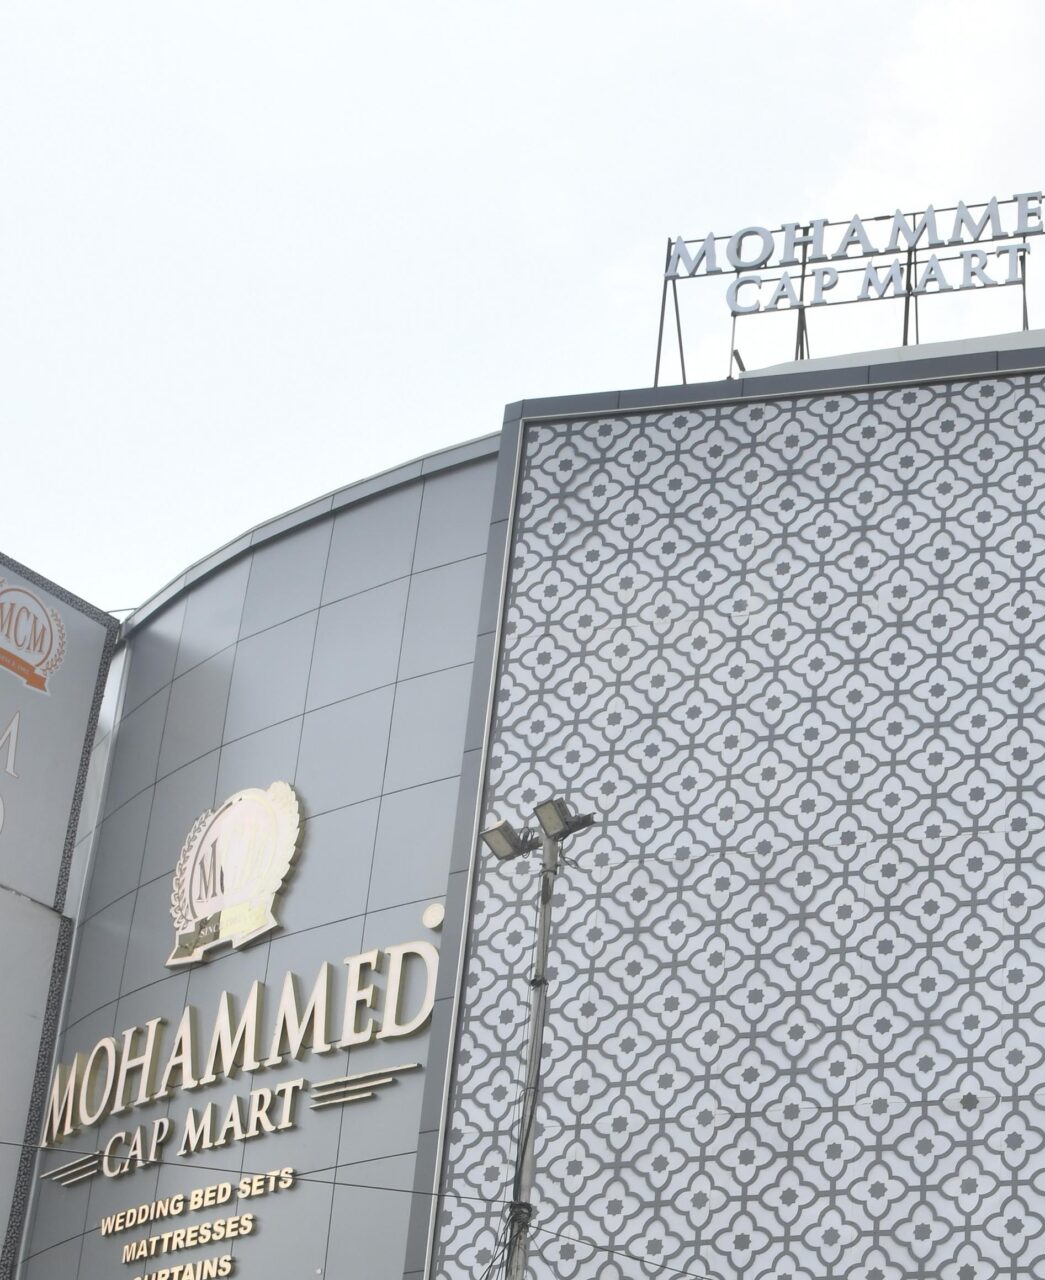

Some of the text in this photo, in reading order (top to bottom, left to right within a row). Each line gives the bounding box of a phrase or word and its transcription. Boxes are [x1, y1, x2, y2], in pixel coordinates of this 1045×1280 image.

[726, 243, 1030, 314] CAP MART
[40, 939, 440, 1147] MOHAMMED
[101, 1078, 305, 1178] CAP MART
[100, 1167, 294, 1236] WEDDING BED SETS
[122, 1213, 254, 1263] MATTRESSES
